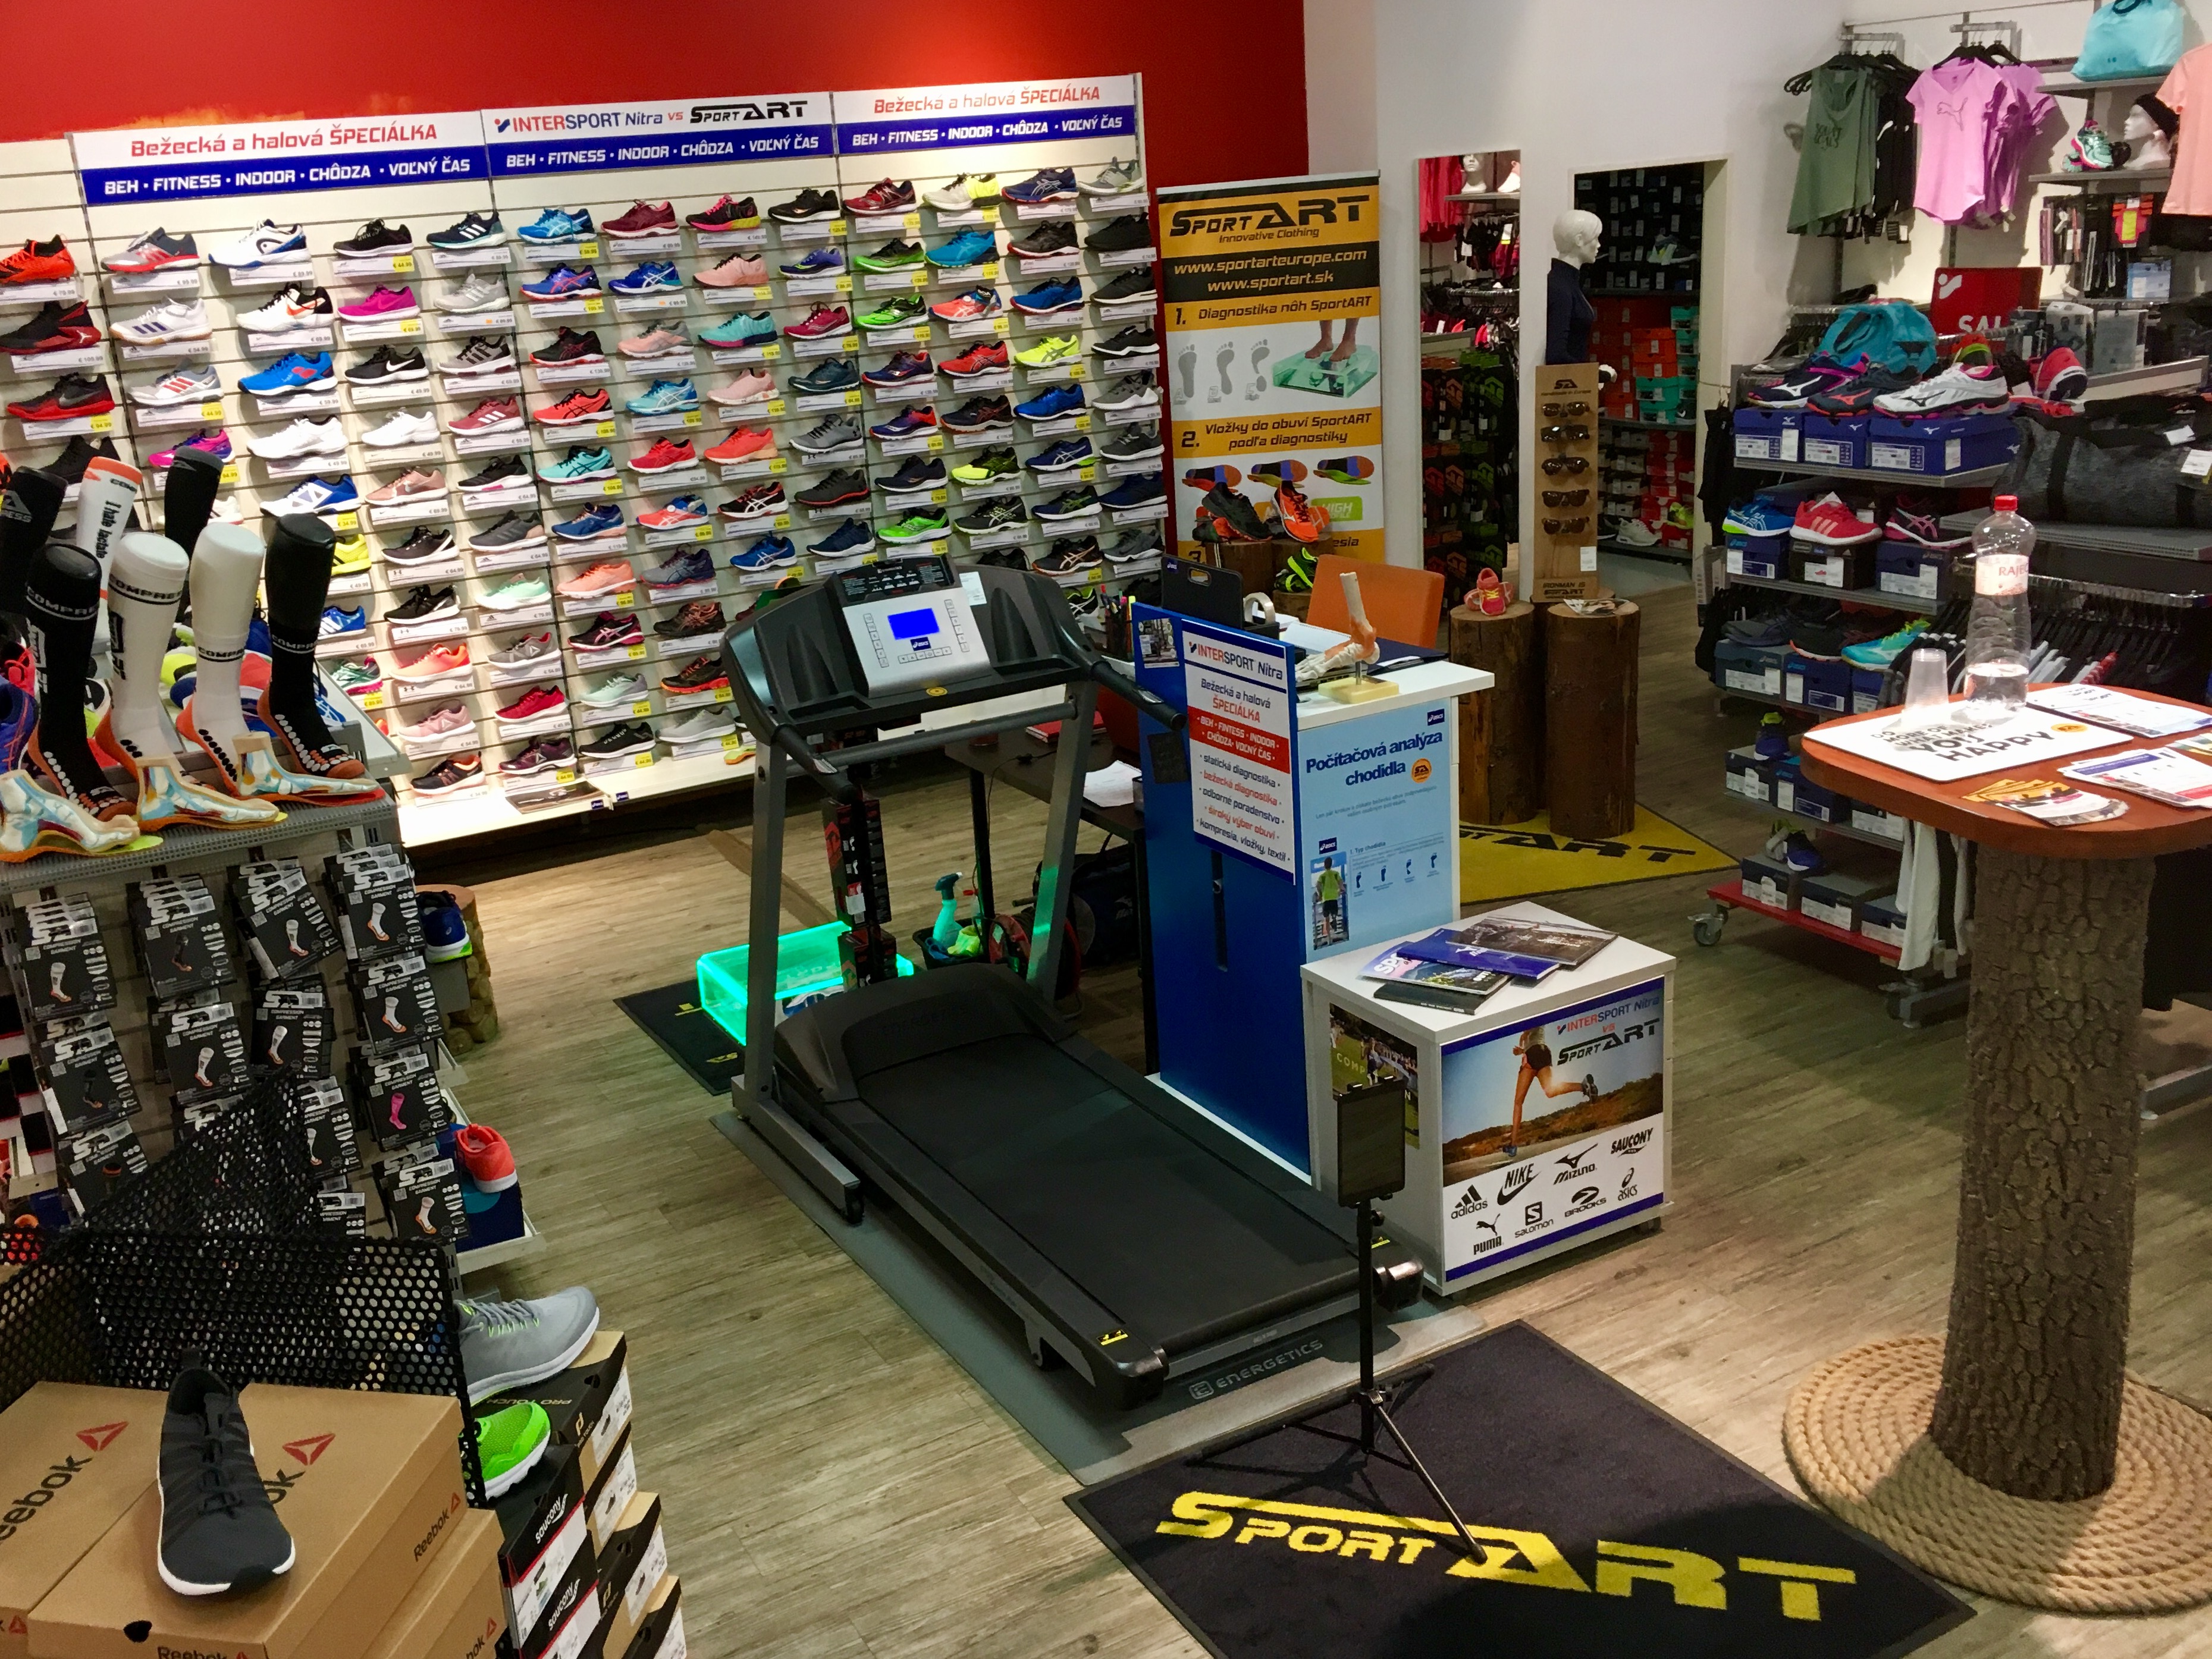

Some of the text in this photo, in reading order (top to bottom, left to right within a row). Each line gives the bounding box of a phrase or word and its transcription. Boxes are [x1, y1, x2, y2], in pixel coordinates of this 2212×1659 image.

[874, 83, 1100, 114] Bežecká a halová ŠPECIÁLKA
[513, 112, 620, 133] INTERSPORT
[625, 111, 663, 126] Nitra
[852, 114, 1123, 146] BEH FITNESS INDOOR CHÔDZA VOĽNÝ ČAS
[131, 124, 437, 158] Bežecká a halová ŠPECIÁLKA
[507, 131, 819, 168] BEH FITNESS INDOOR CHÔDZA VOĽNÝ ČAS
[105, 156, 470, 195] BEH FITNESS INDOOR CHÔDZA VOĽNÝ ČAS
[1219, 228, 1319, 243] Innovative Clothing
[1174, 250, 1367, 275] www.sportarteurope.com
[1207, 270, 1334, 292] www.sportart.sk
[1175, 296, 1372, 325] 1. Diagnostika nôh SportART
[206, 409, 222, 417] 44.99
[1181, 413, 1372, 448] 2. Vložky do obuvi SportART
[1228, 431, 1348, 451] podľa diagnostiky
[101, 507, 120, 527] hate
[105, 500, 122, 509] I
[96, 529, 113, 559] lactate
[1197, 644, 1283, 680] INTERSPORT Nitra
[1201, 678, 1271, 709] Bežecká a halová
[1213, 694, 1260, 723] ŠPECIÁLKA
[1200, 715, 1215, 728] BEH
[1250, 732, 1276, 749] INDOOR
[1883, 725, 1948, 743] MORE OF
[1894, 734, 1942, 746] WHAT
[1935, 730, 2055, 762] HAPPY
[1258, 746, 1272, 761] ČAS
[1306, 731, 1444, 774] Počítačová analýza
[1204, 754, 1276, 788] statická diagnostika
[1345, 761, 1407, 786] chodidla
[1203, 769, 1278, 806] bežecká diagnostika
[1203, 788, 1281, 825] odborné poradenstvo
[1208, 805, 1276, 840] široký výber obuvi
[1200, 818, 1287, 862] kompresia, vložky, textil
[1567, 996, 1660, 1032] INTERSPORT Nitra
[1611, 1127, 1654, 1155] SAUCONY
[1504, 1163, 1535, 1189] NIKE
[1564, 1197, 1607, 1218] BROOKS
[1618, 1184, 1638, 1202] asics
[1451, 1199, 1488, 1220] adidas
[1473, 1236, 1502, 1255] PUMA
[1216, 1340, 1323, 1388] ENERGETICS
[413, 1507, 451, 1563] Reebok
[535, 1496, 562, 1544] saucony
[548, 1581, 574, 1632] saucony
